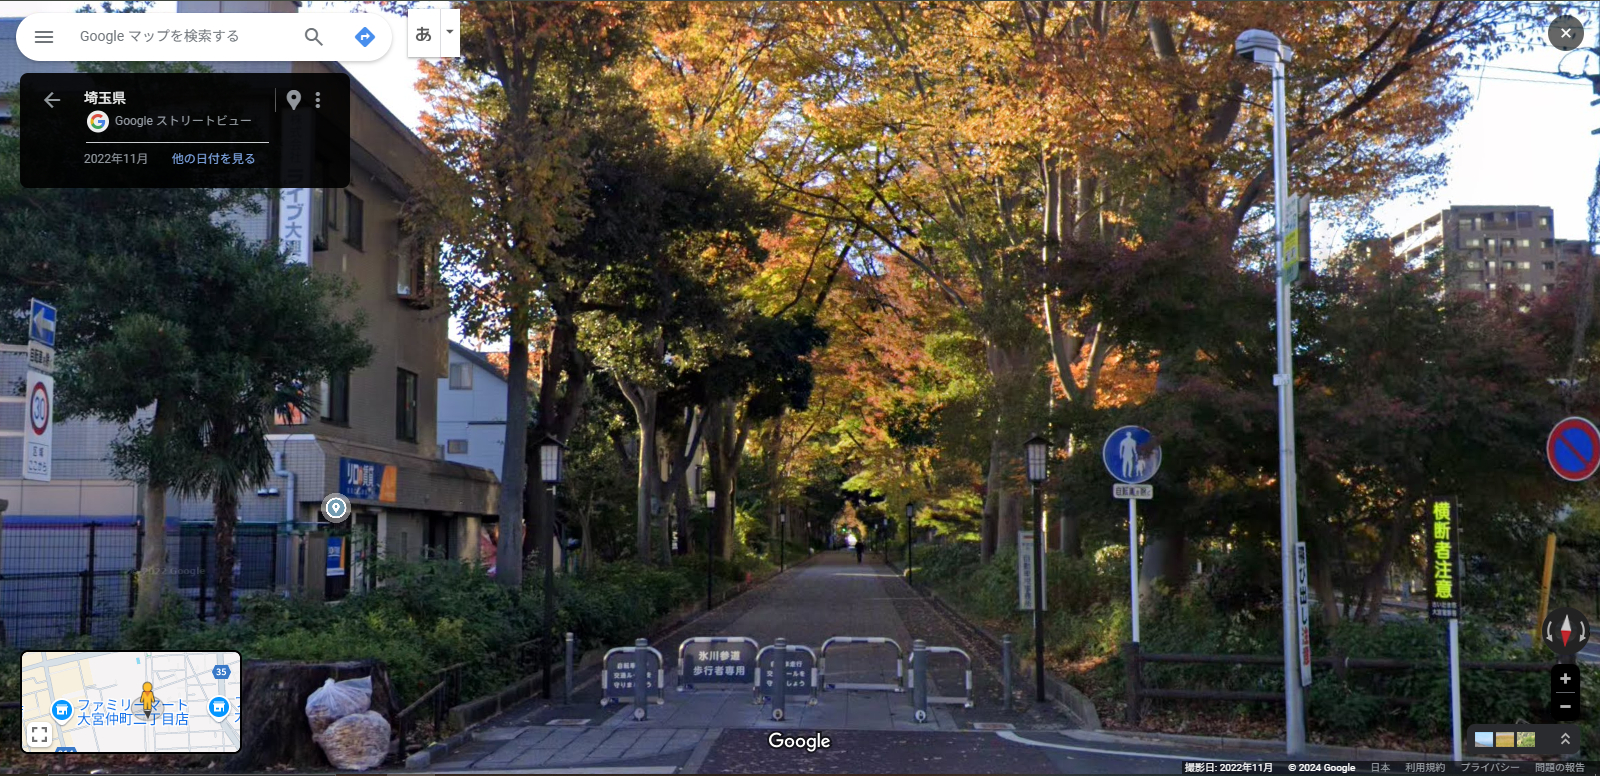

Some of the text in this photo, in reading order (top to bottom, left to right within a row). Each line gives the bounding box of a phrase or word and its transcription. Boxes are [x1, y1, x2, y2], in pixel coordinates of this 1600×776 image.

[34, 396, 45, 420] 30
[1432, 501, 1453, 599] 横断者注意
[698, 650, 741, 661] 氷川参道
[693, 665, 746, 676] 歩行者専用
